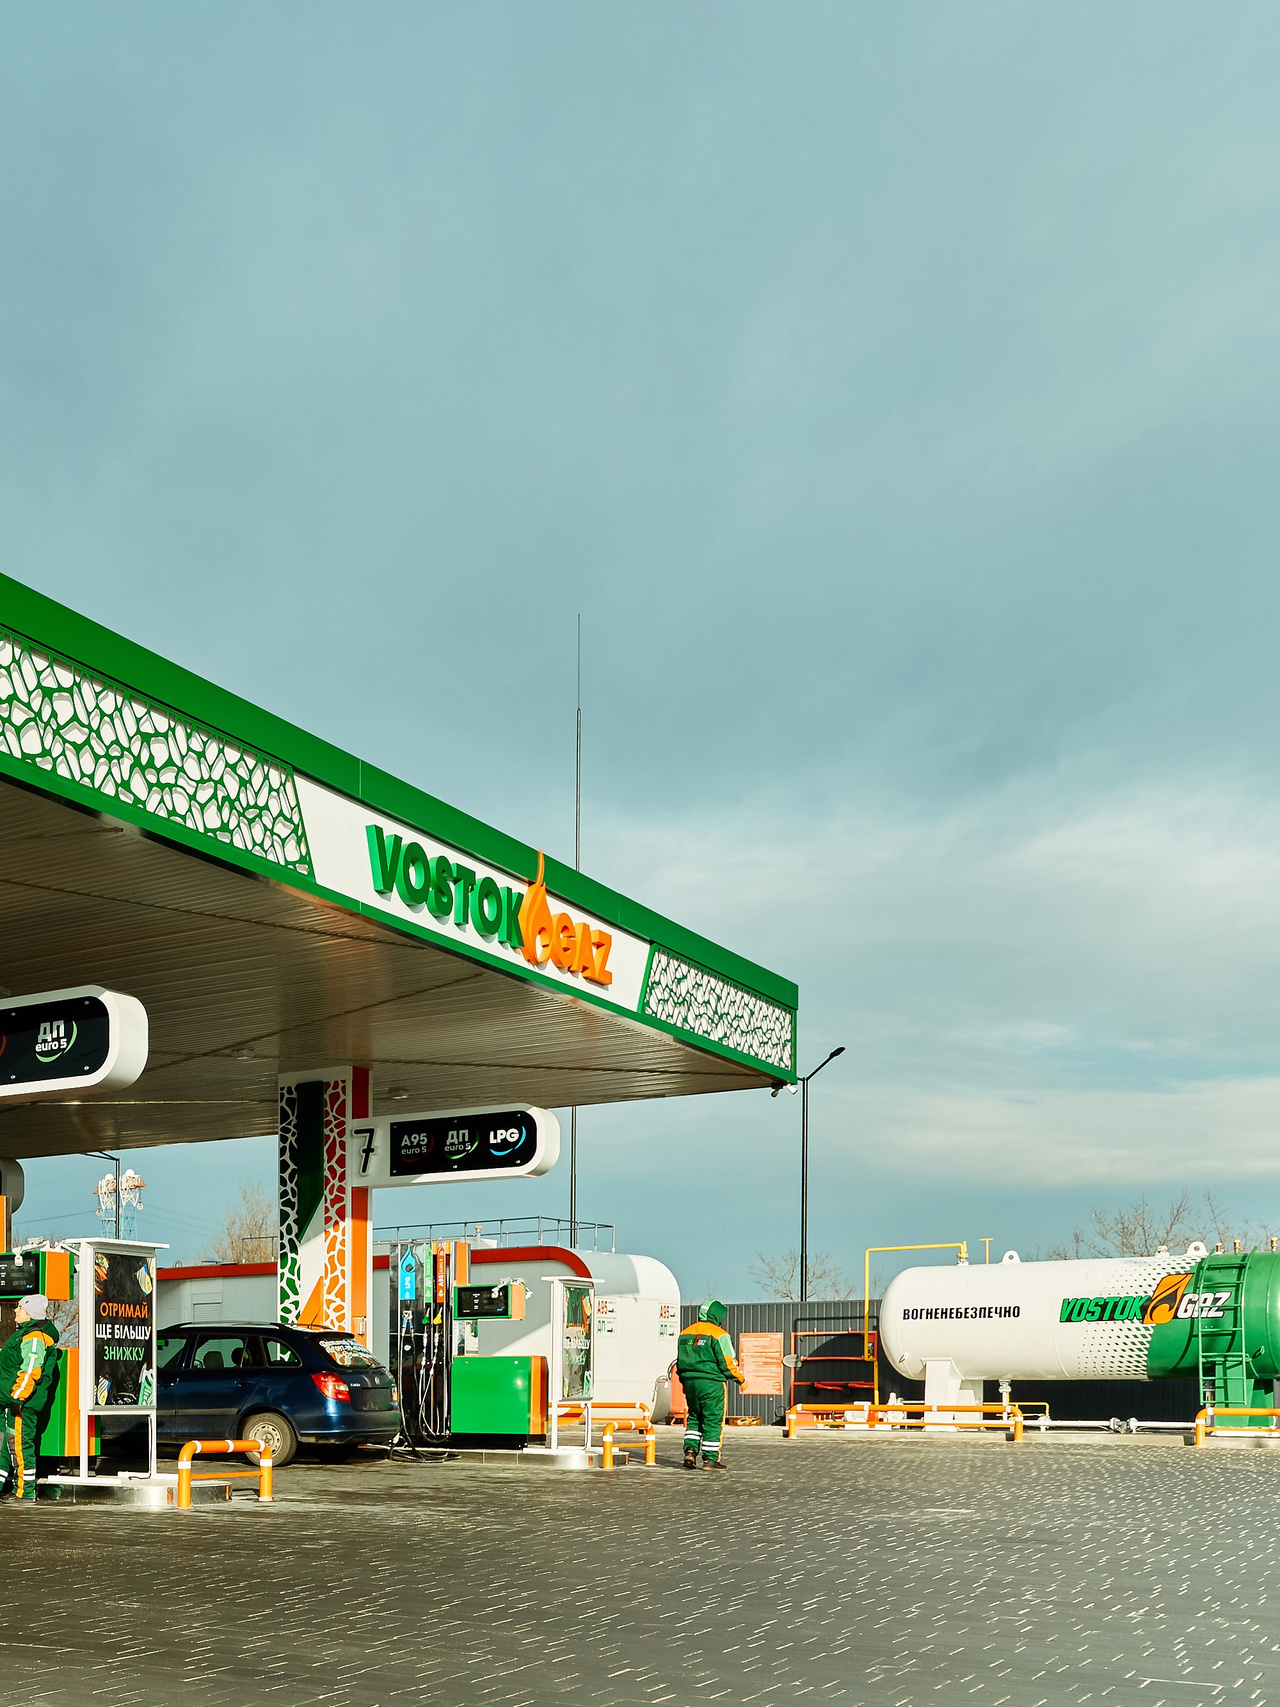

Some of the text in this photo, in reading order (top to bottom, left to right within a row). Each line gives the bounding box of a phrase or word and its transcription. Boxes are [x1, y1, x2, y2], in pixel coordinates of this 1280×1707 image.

[365, 824, 613, 986] VOSTOK GAZ
[37, 1020, 66, 1043] ДП
[35, 1040, 67, 1052] euro 5
[401, 1133, 428, 1147] A95
[446, 1129, 469, 1145] ДП
[489, 1128, 520, 1144] LPG
[353, 1128, 375, 1174] 7
[401, 1146, 427, 1155] euro 5
[444, 1142, 471, 1152] euro 5
[100, 1302, 148, 1319] ОТРИМАЙ
[902, 1305, 1021, 1321] ВОГНЕНЕБЕЗПЕЧНО
[1059, 1291, 1232, 1323] VOSTOK GAZ
[96, 1323, 151, 1341] ЩЕ БІЛЬШУ
[103, 1345, 145, 1362] ЗНИЖКУ
